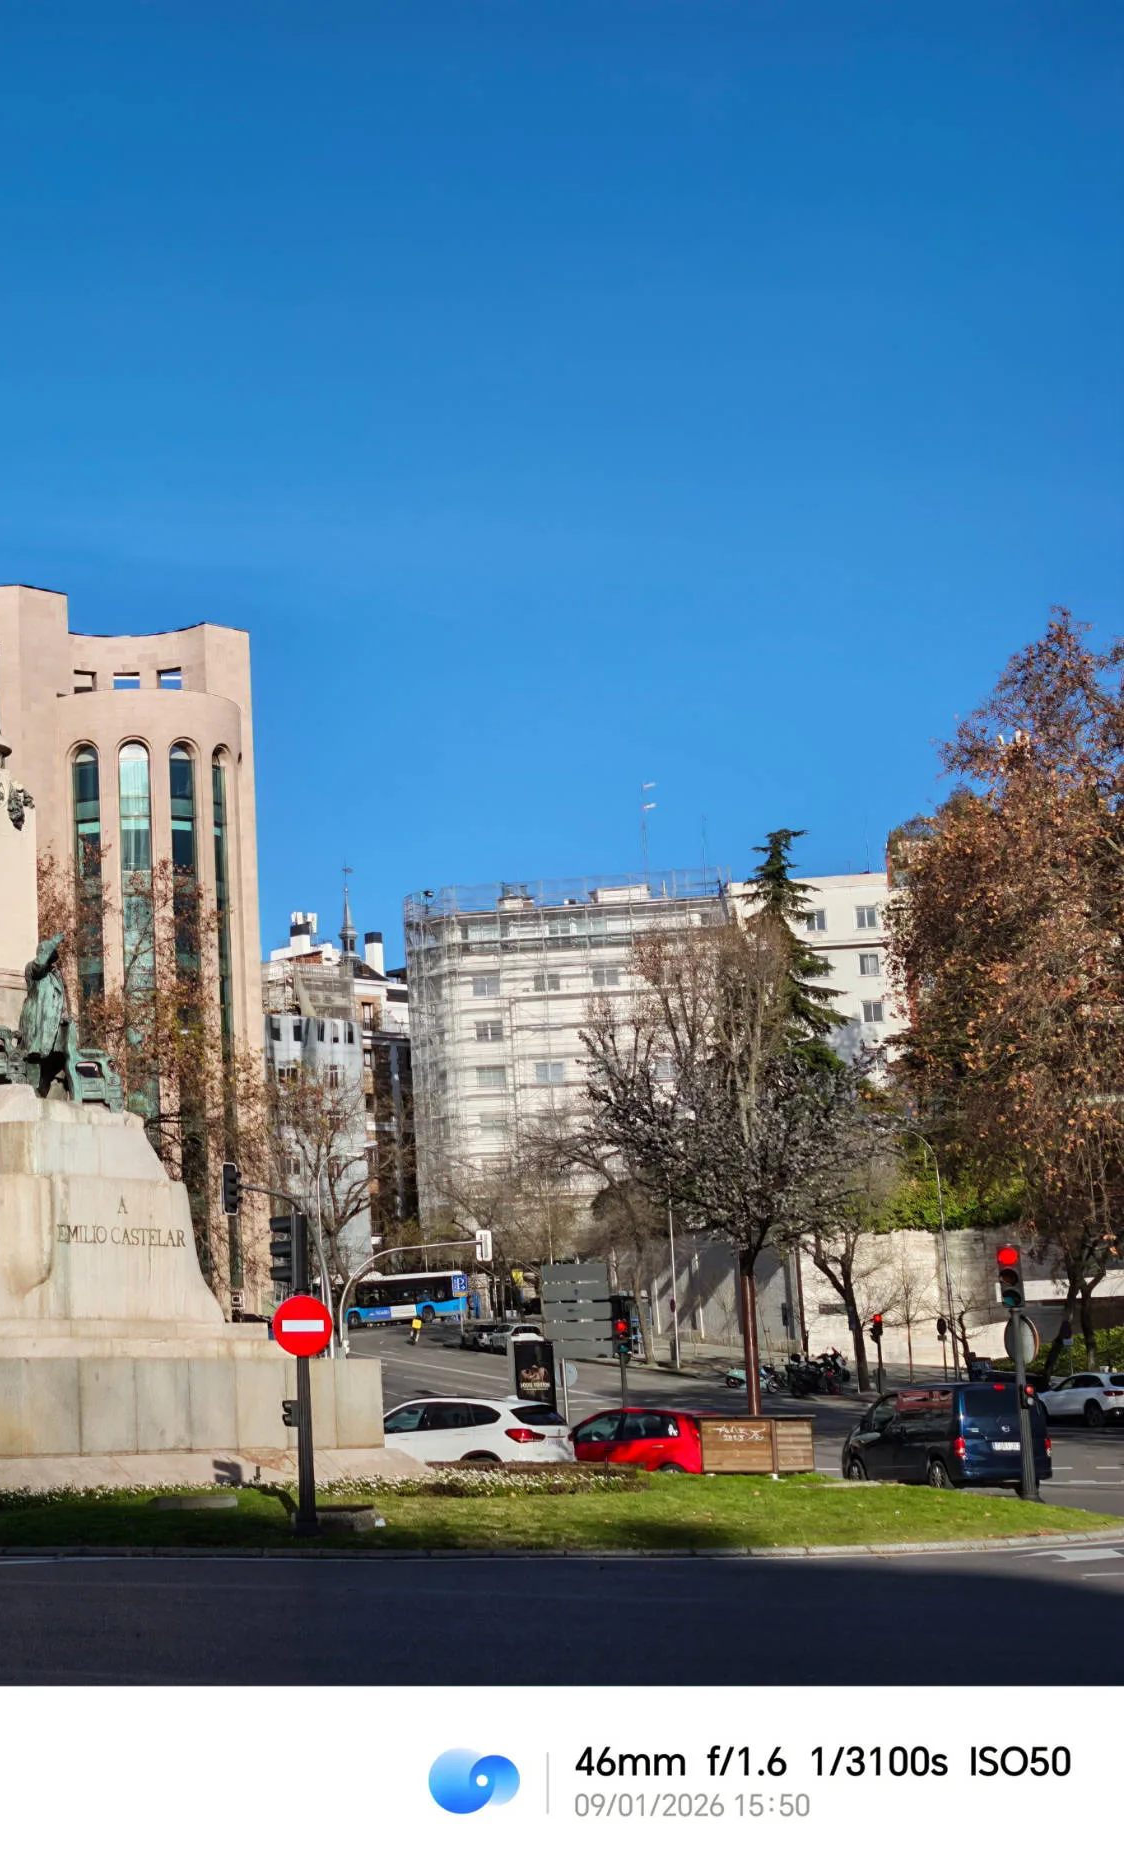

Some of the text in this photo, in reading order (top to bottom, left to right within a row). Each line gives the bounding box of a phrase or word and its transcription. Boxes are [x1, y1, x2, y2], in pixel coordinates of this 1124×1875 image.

[117, 1194, 128, 1215] A
[56, 1223, 187, 1248] EMILIO CASTELAR
